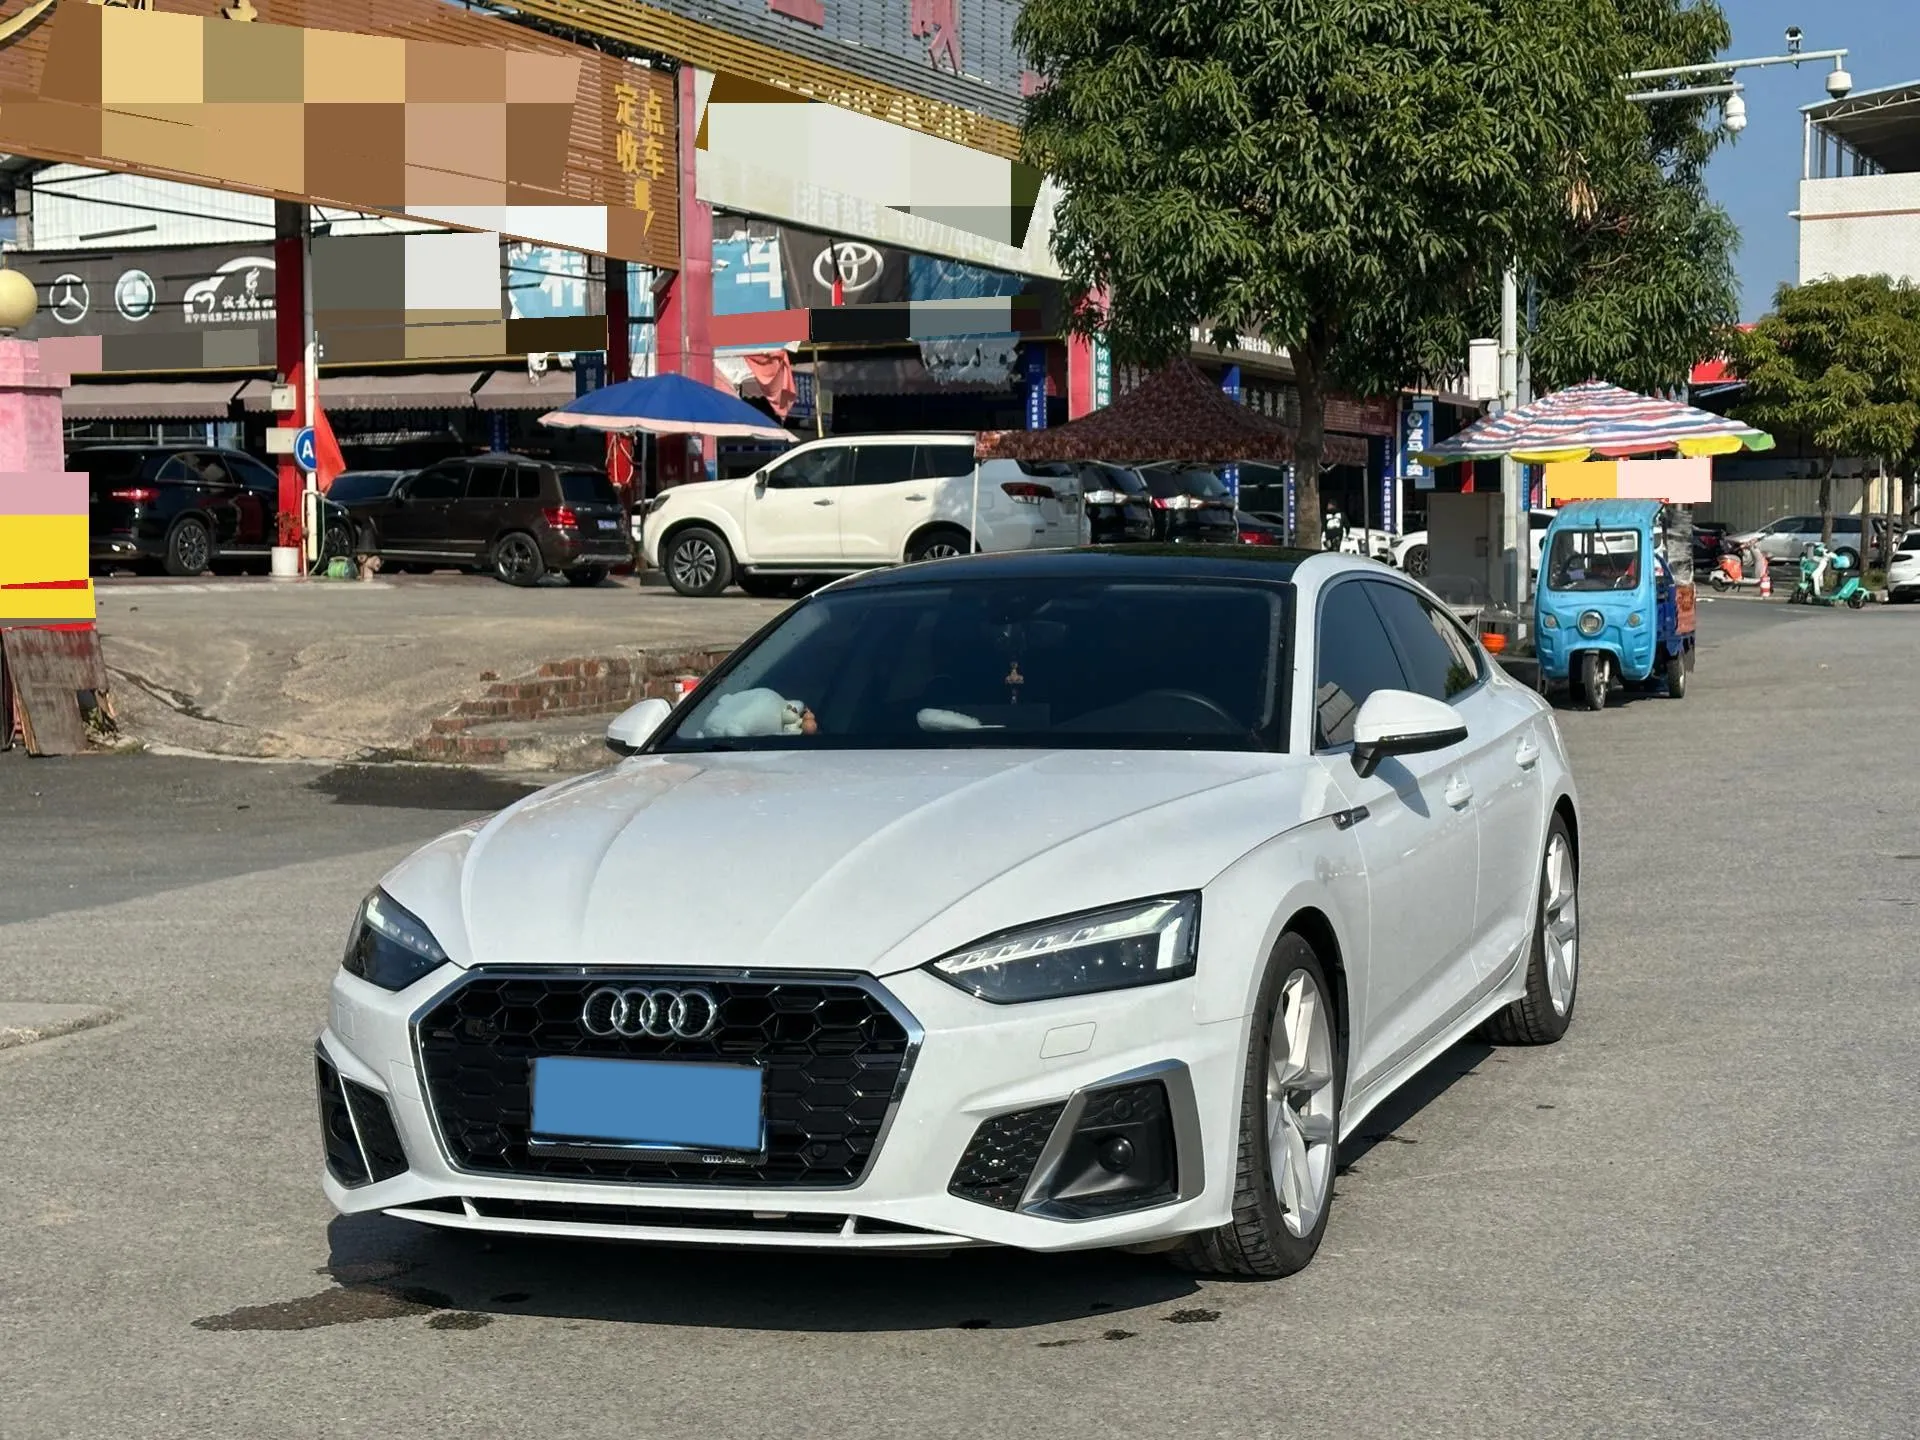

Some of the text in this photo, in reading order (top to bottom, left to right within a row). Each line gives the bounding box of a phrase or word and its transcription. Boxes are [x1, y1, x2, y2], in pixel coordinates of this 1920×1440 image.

[615, 82, 665, 136] 定点
[616, 128, 665, 180] 收车
[1096, 332, 1111, 411] 价收新能
[302, 439, 314, 459] A
[724, 1155, 746, 1164] Audi
